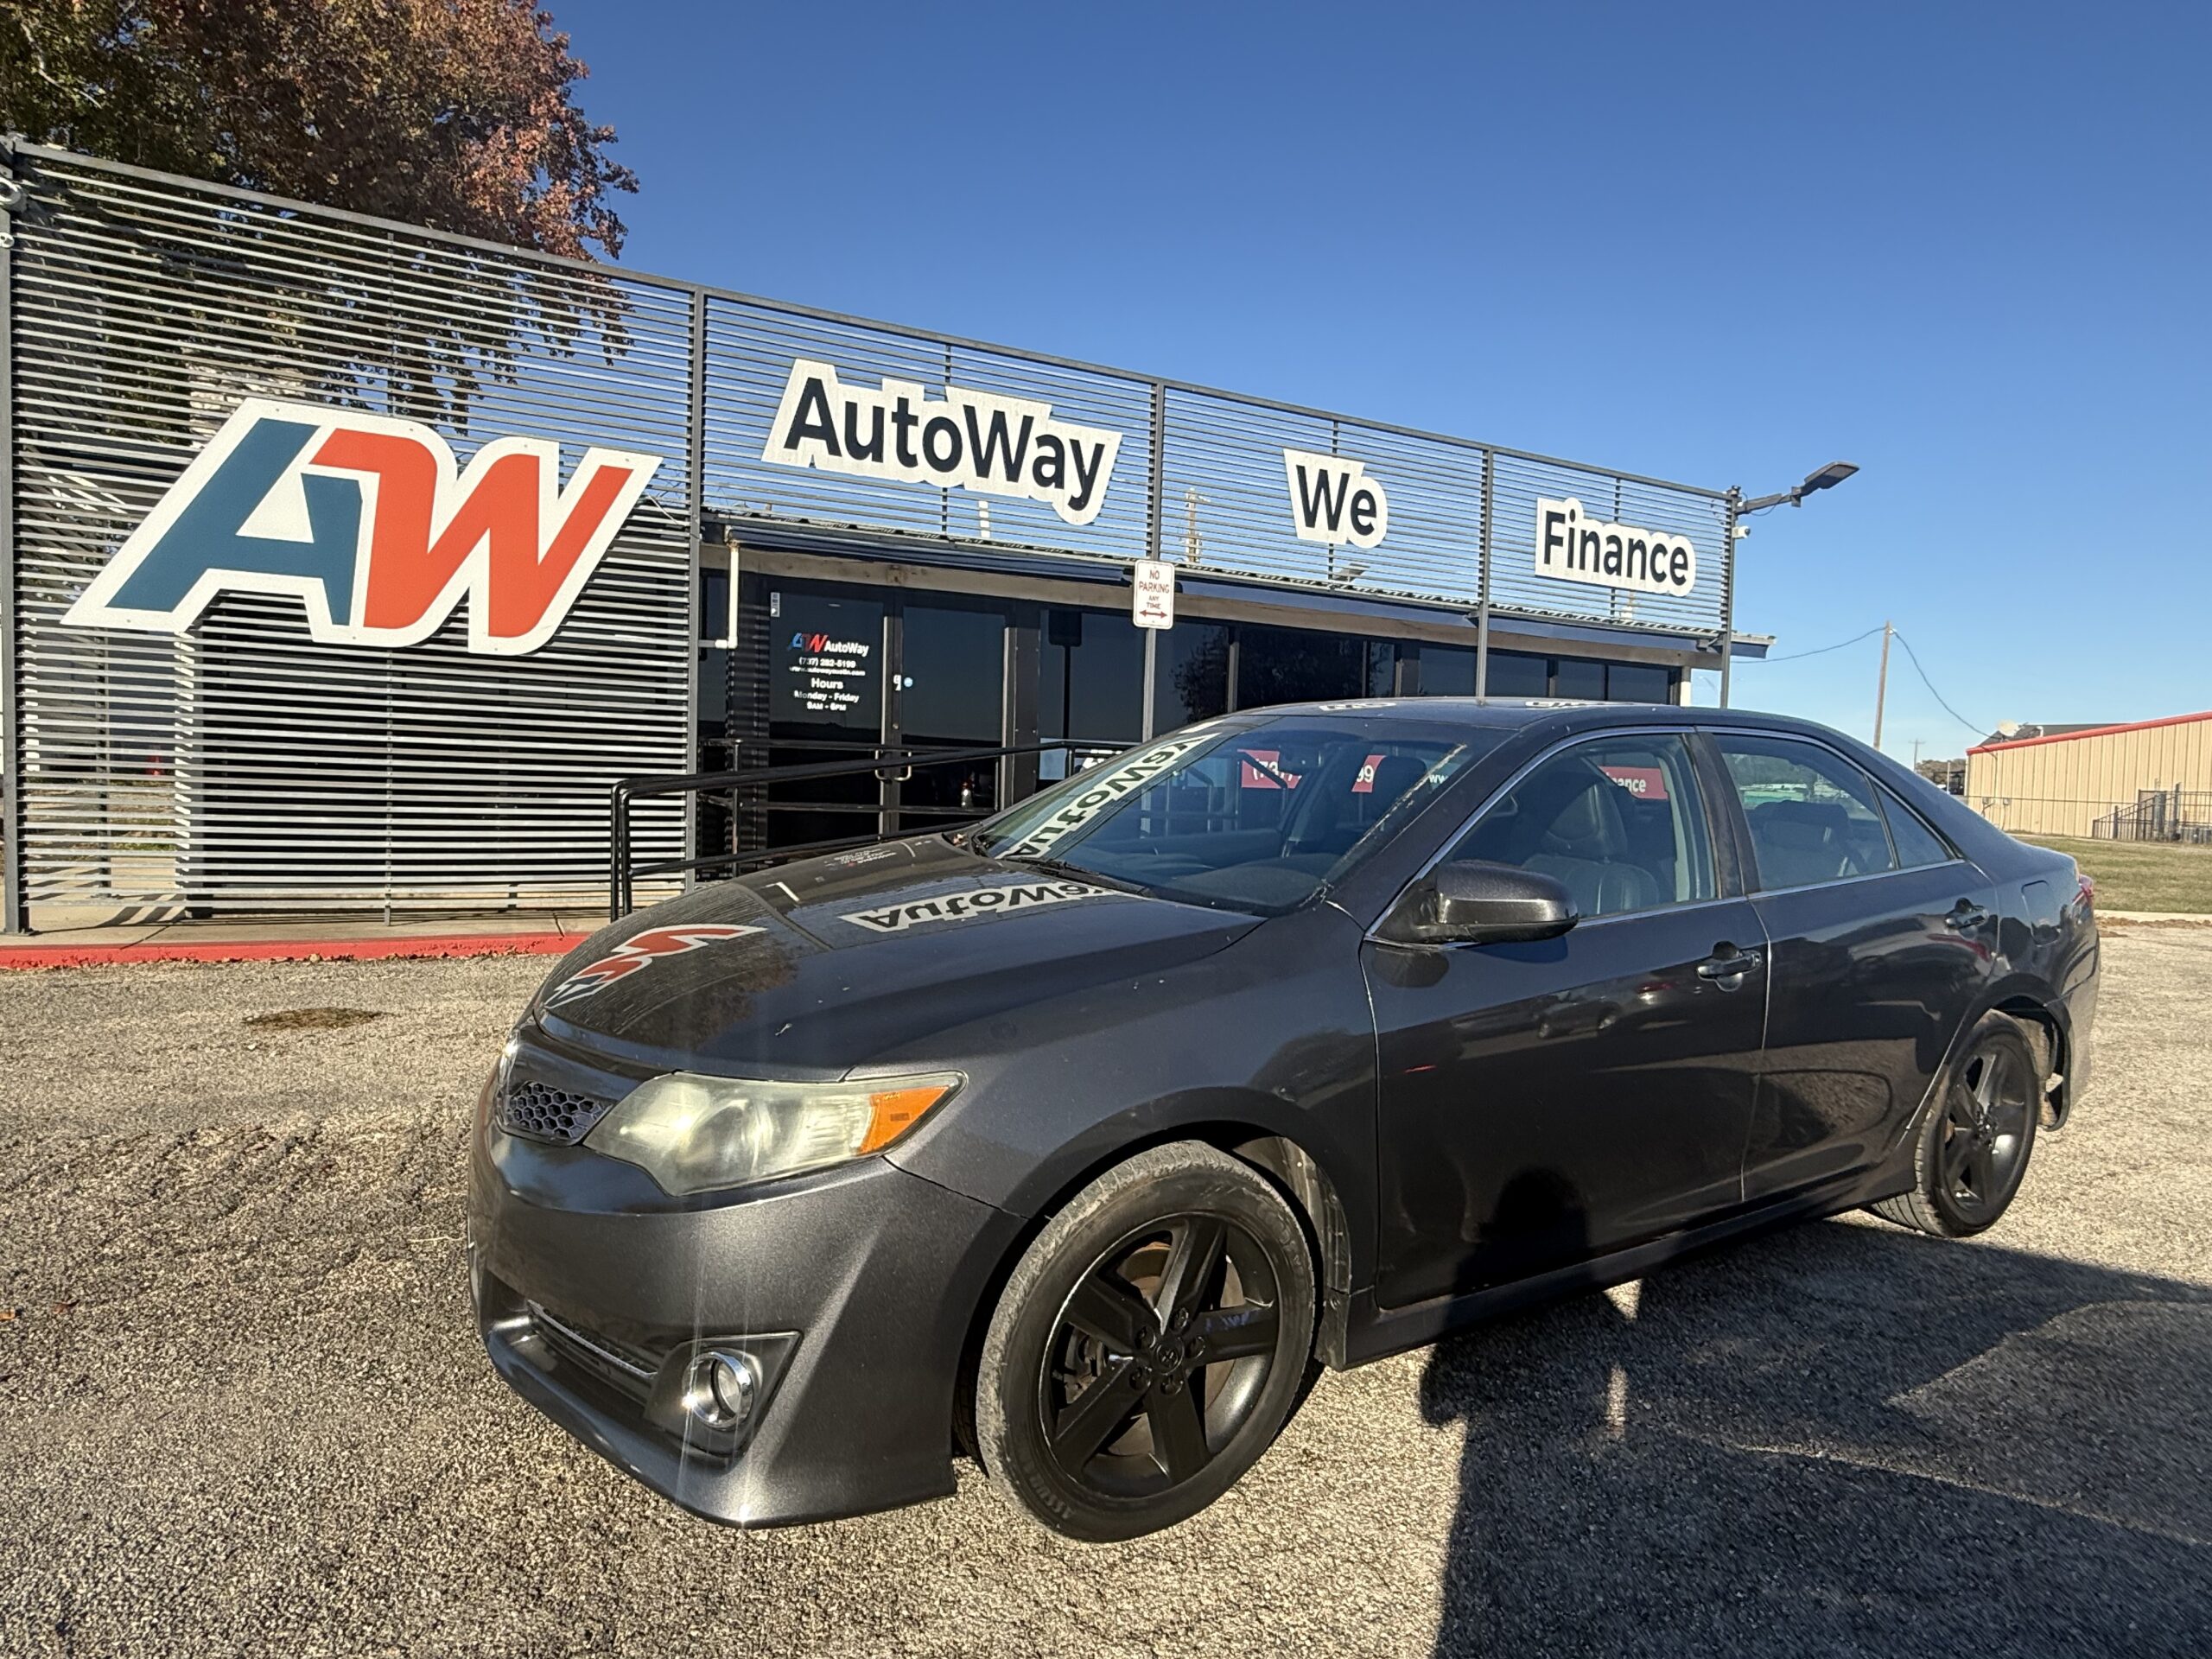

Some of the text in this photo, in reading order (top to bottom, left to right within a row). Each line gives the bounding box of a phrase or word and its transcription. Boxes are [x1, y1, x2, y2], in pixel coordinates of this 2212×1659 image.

[783, 377, 1106, 512] AutoWay
[1295, 464, 1378, 537] We
[105, 416, 634, 638] AW
[1543, 508, 1689, 586] Finance
[1149, 569, 1160, 580] NO
[1138, 581, 1170, 594] PARKING
[823, 640, 869, 658] AutoWay
[798, 657, 819, 667] (737)
[810, 677, 844, 690] Hours
[793, 690, 828, 702] Monday
[833, 692, 860, 703] Friday
[806, 701, 823, 710] 9AM
